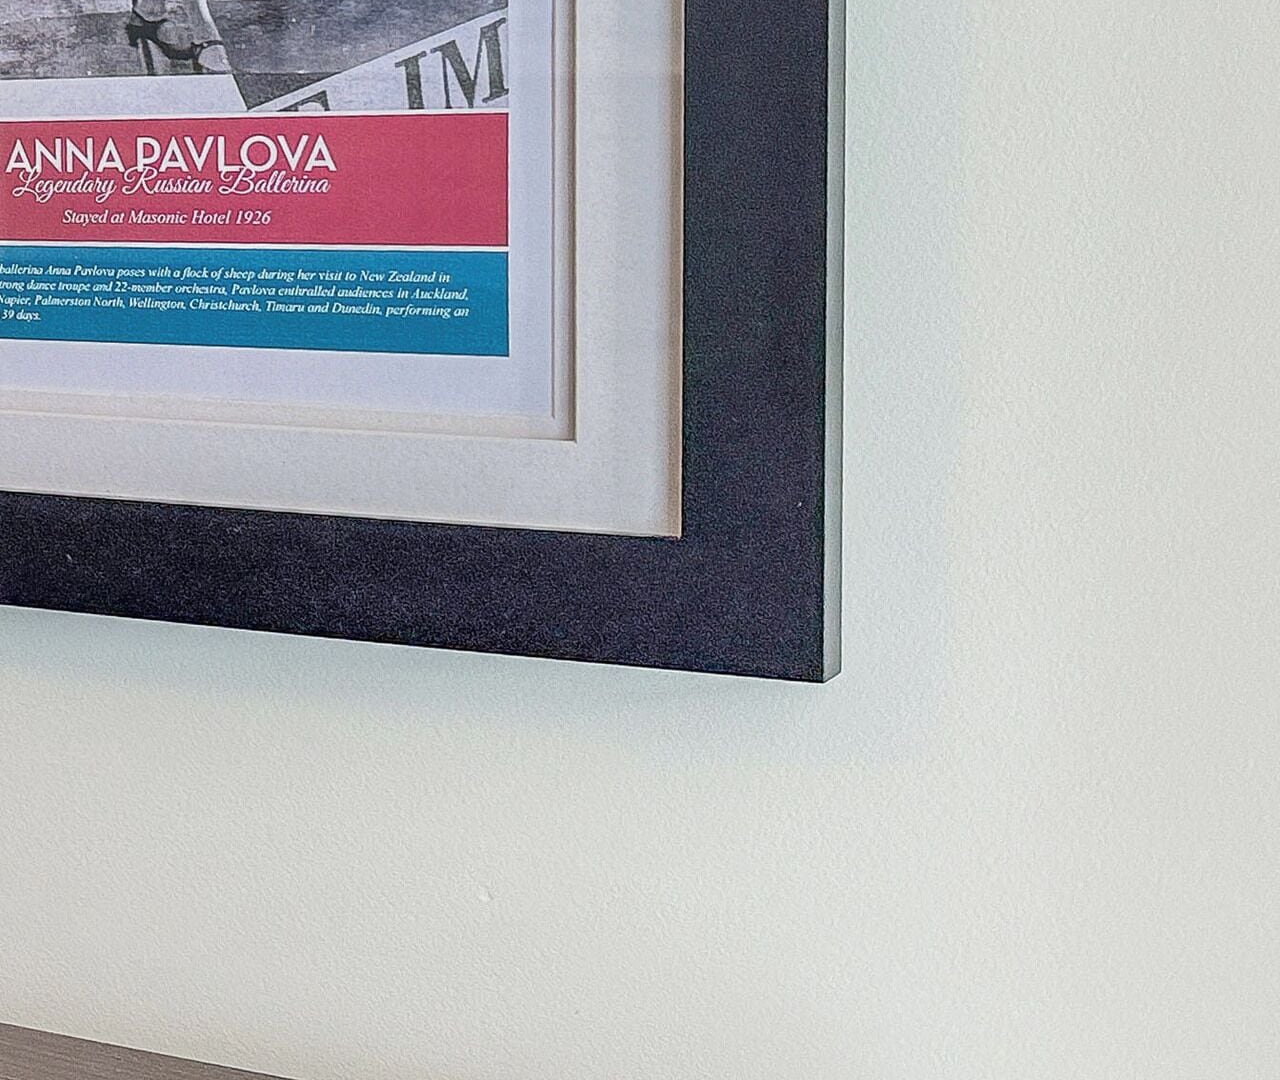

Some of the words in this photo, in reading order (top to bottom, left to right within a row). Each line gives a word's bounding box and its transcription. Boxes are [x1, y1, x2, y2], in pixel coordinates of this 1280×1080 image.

[5, 137, 126, 174] ANNA
[136, 134, 337, 172] PAVLOVA
[12, 166, 117, 203] Legendary
[122, 166, 213, 194] Russian
[219, 167, 331, 194] Ballerina
[62, 209, 108, 227] Stayed
[110, 211, 125, 224] at
[128, 209, 188, 225] Masonic
[191, 209, 232, 224] Hotel
[236, 210, 272, 225] 1926
[0, 263, 43, 274] ballerina
[44, 265, 71, 275] Anna
[73, 265, 115, 276] Pavlova
[116, 268, 145, 278] poses
[148, 266, 171, 277] with
[180, 266, 208, 280] flock
[210, 267, 224, 281] of
[223, 267, 255, 281] sheep
[257, 268, 294, 282] during
[297, 269, 316, 280] her
[318, 270, 342, 280] visit
[344, 271, 356, 281] to
[359, 270, 385, 281] New
[388, 270, 436, 282] Zealand
[438, 272, 450, 283] in
[26, 279, 56, 290] dance
[58, 282, 90, 293] troupe
[92, 281, 113, 291] and
[114, 281, 172, 292] 22-member
[231, 283, 275, 295] Pavlova
[278, 285, 335, 296] enthralled
[337, 286, 393, 298] audiences
[396, 287, 409, 298] in
[34, 294, 91, 306] Palmerston
[266, 300, 304, 312] Timaru
[307, 301, 329, 312] and
[385, 304, 450, 318] performing
[453, 308, 469, 316] an
